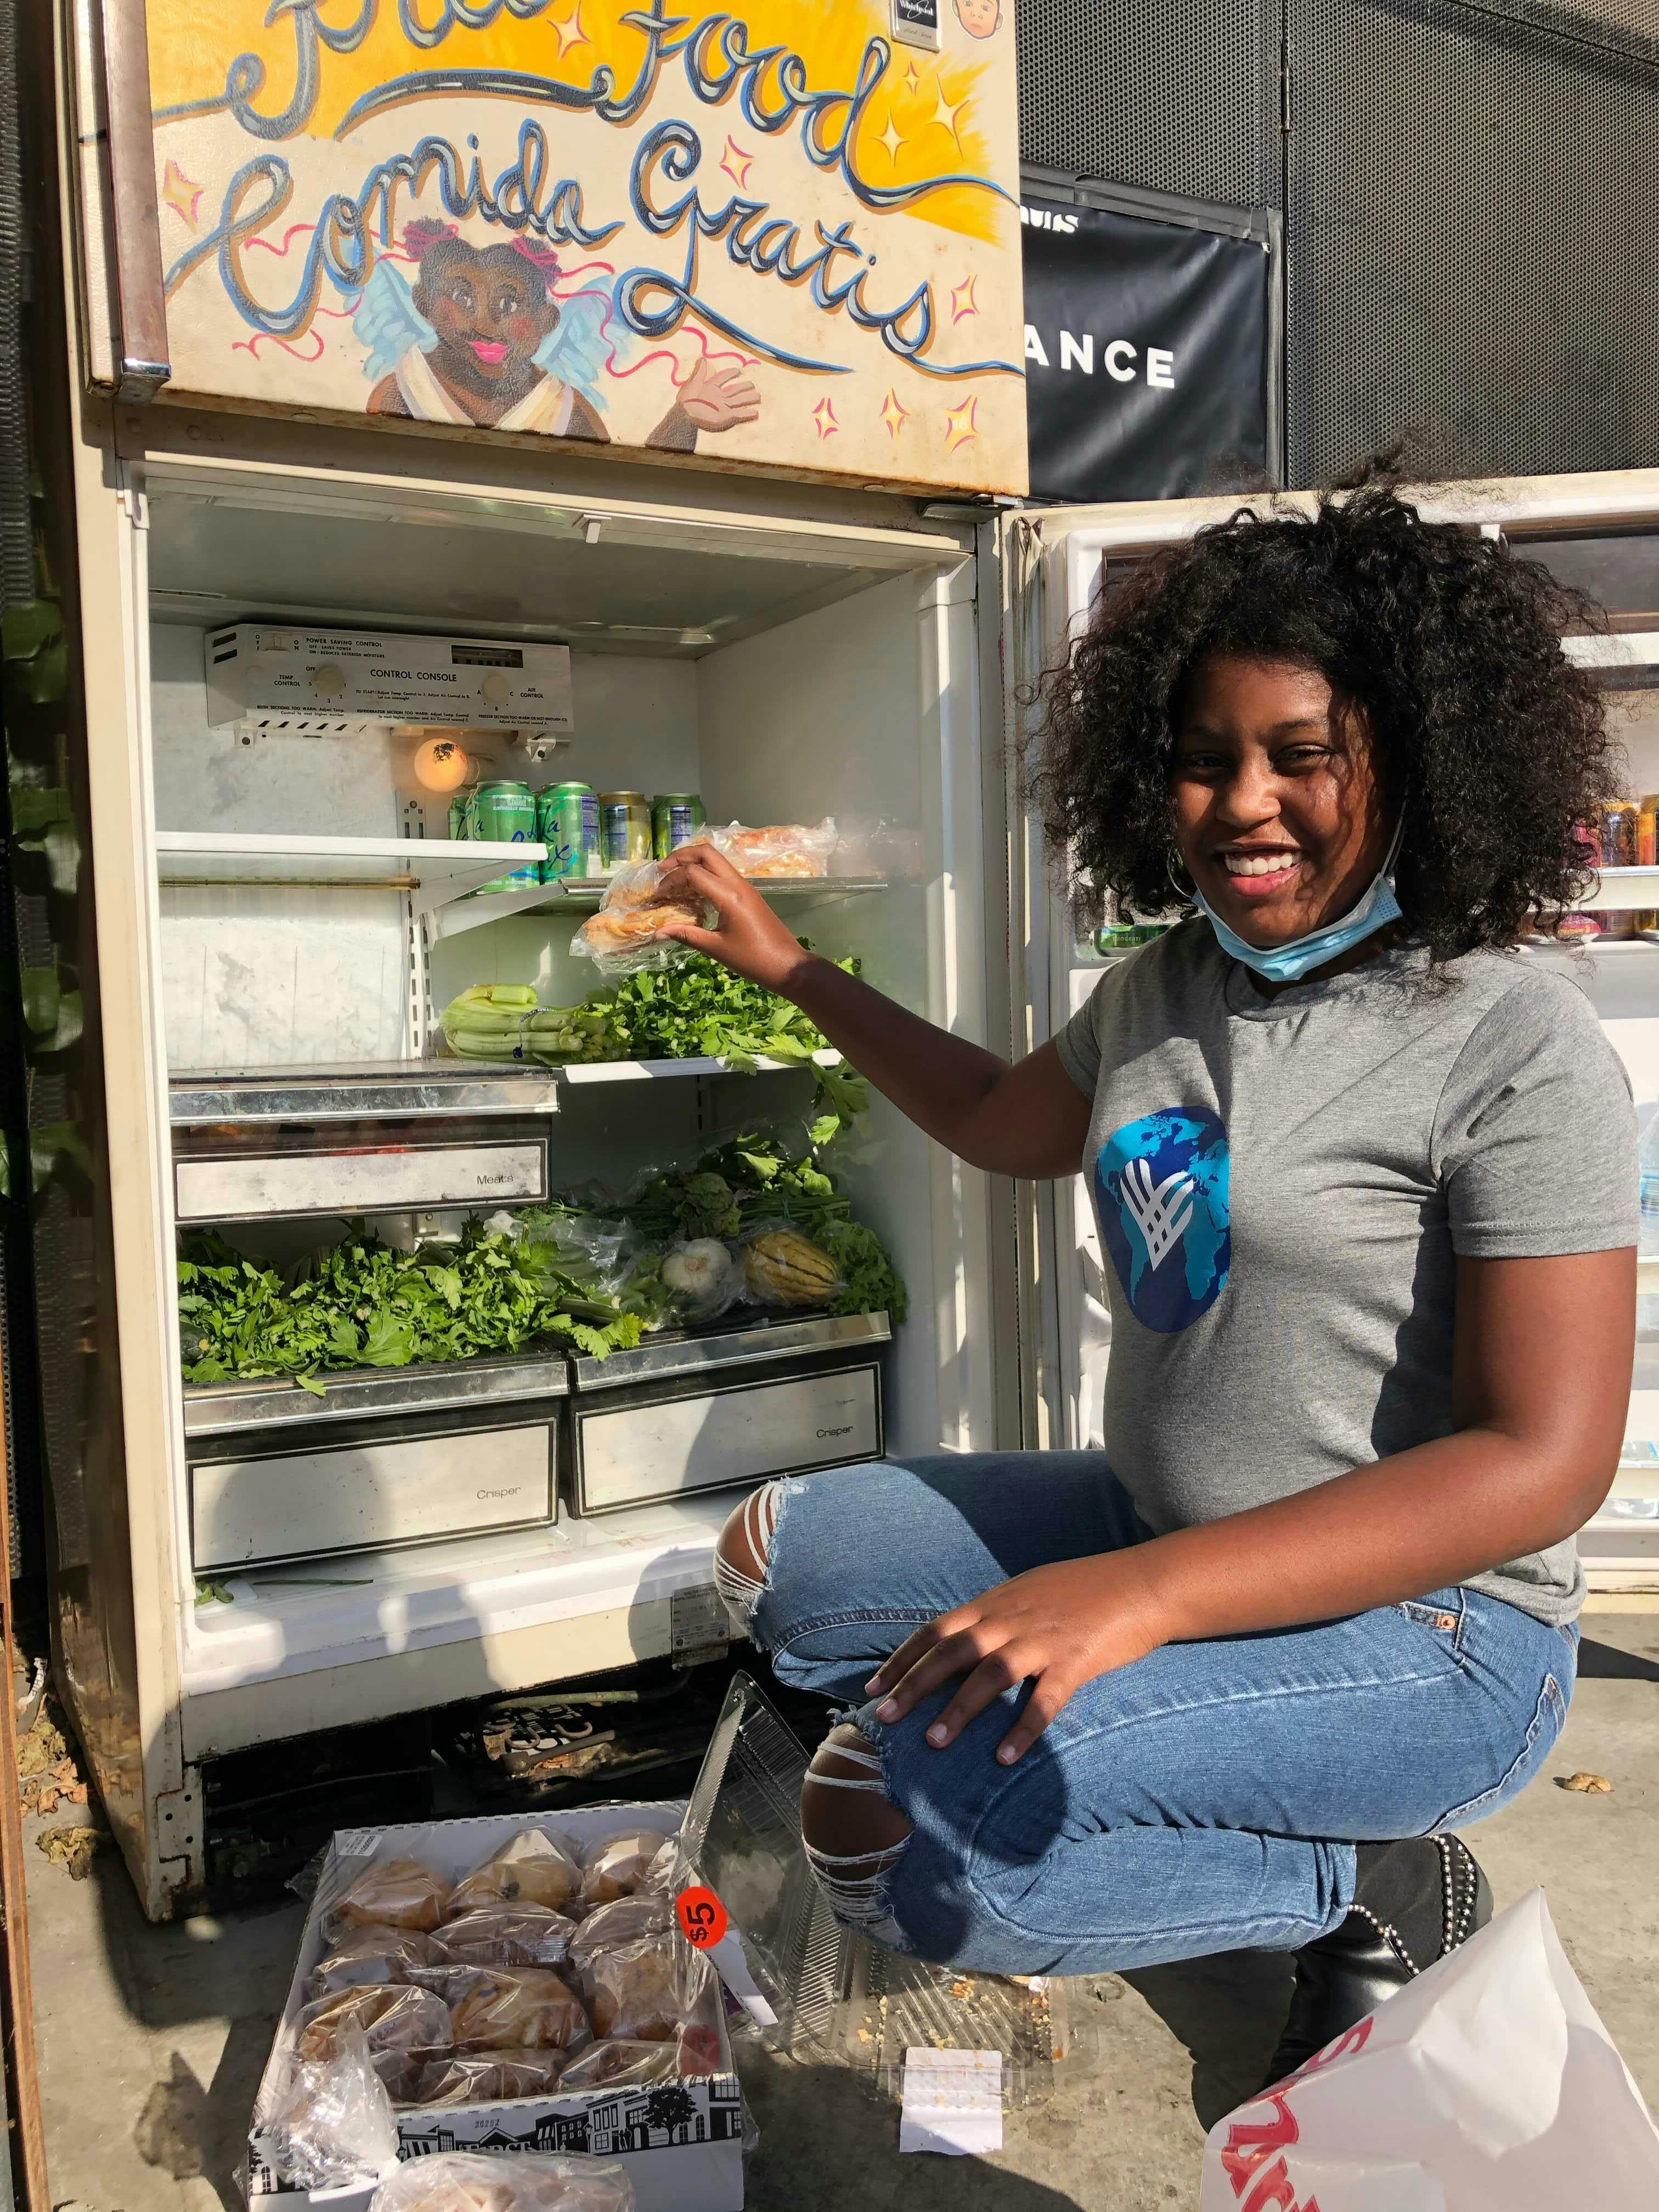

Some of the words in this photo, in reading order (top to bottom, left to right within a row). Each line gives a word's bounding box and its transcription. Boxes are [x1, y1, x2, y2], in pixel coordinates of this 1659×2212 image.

[165, 118, 625, 337] Comida
[613, 118, 1025, 380] Gratis
[1024, 324, 1175, 388] ANCE
[370, 669, 412, 679] CONTROL
[416, 672, 457, 682] CONSOLE
[477, 1175, 514, 1184] Meats
[816, 1426, 853, 1438] Crisper
[477, 1487, 521, 1499] Crisper
[686, 1902, 715, 1942] $5
